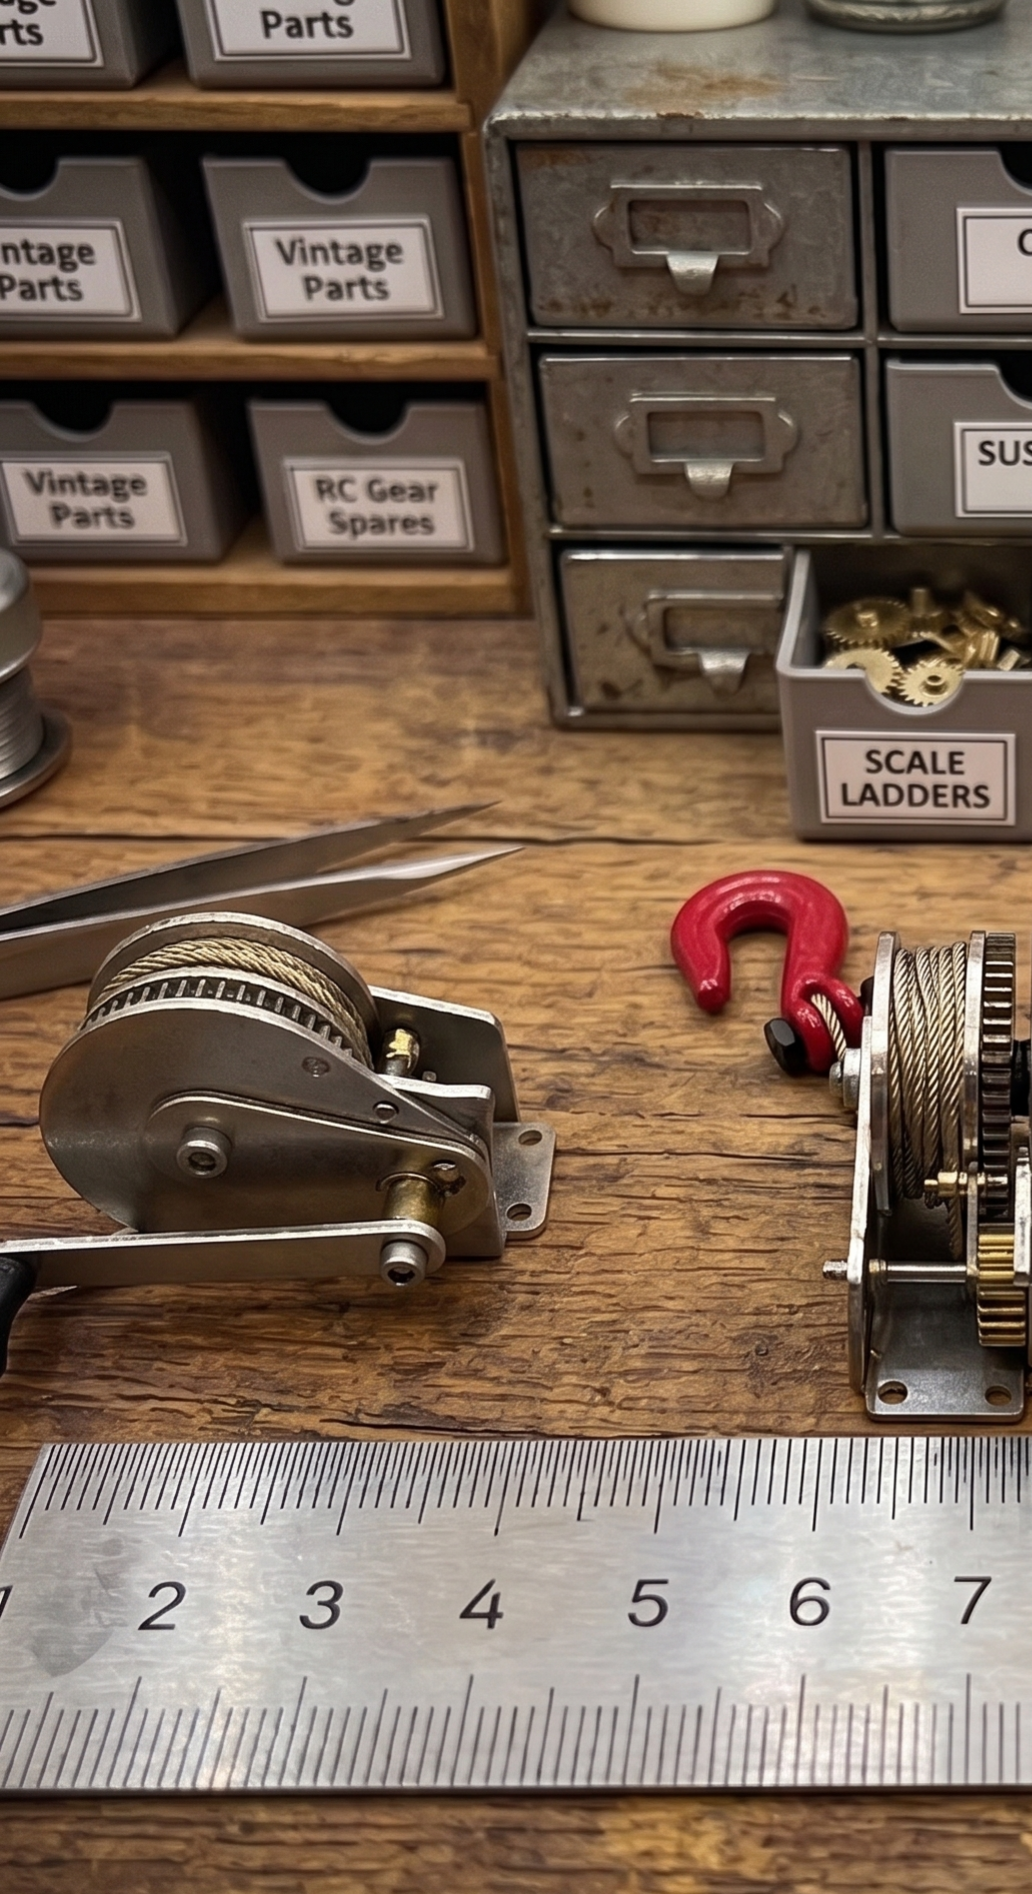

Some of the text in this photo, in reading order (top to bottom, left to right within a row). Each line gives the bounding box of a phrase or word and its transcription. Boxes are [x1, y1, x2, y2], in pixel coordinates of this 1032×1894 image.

[261, 10, 354, 39] Parts
[274, 238, 403, 272] Vintage
[0, 274, 84, 301] Parts
[303, 276, 389, 303] Parts
[24, 469, 147, 502] Vintage
[314, 477, 438, 504] RC Gear
[51, 504, 135, 530] Parts
[328, 510, 436, 541] Spares
[865, 748, 965, 776] SCALE
[842, 783, 991, 809] LADDERS
[137, 1581, 186, 1631] 2
[299, 1580, 344, 1630] 3
[459, 1579, 504, 1630] 4
[627, 1578, 669, 1628] 5
[789, 1577, 831, 1627] 6
[953, 1576, 993, 1625] 7
